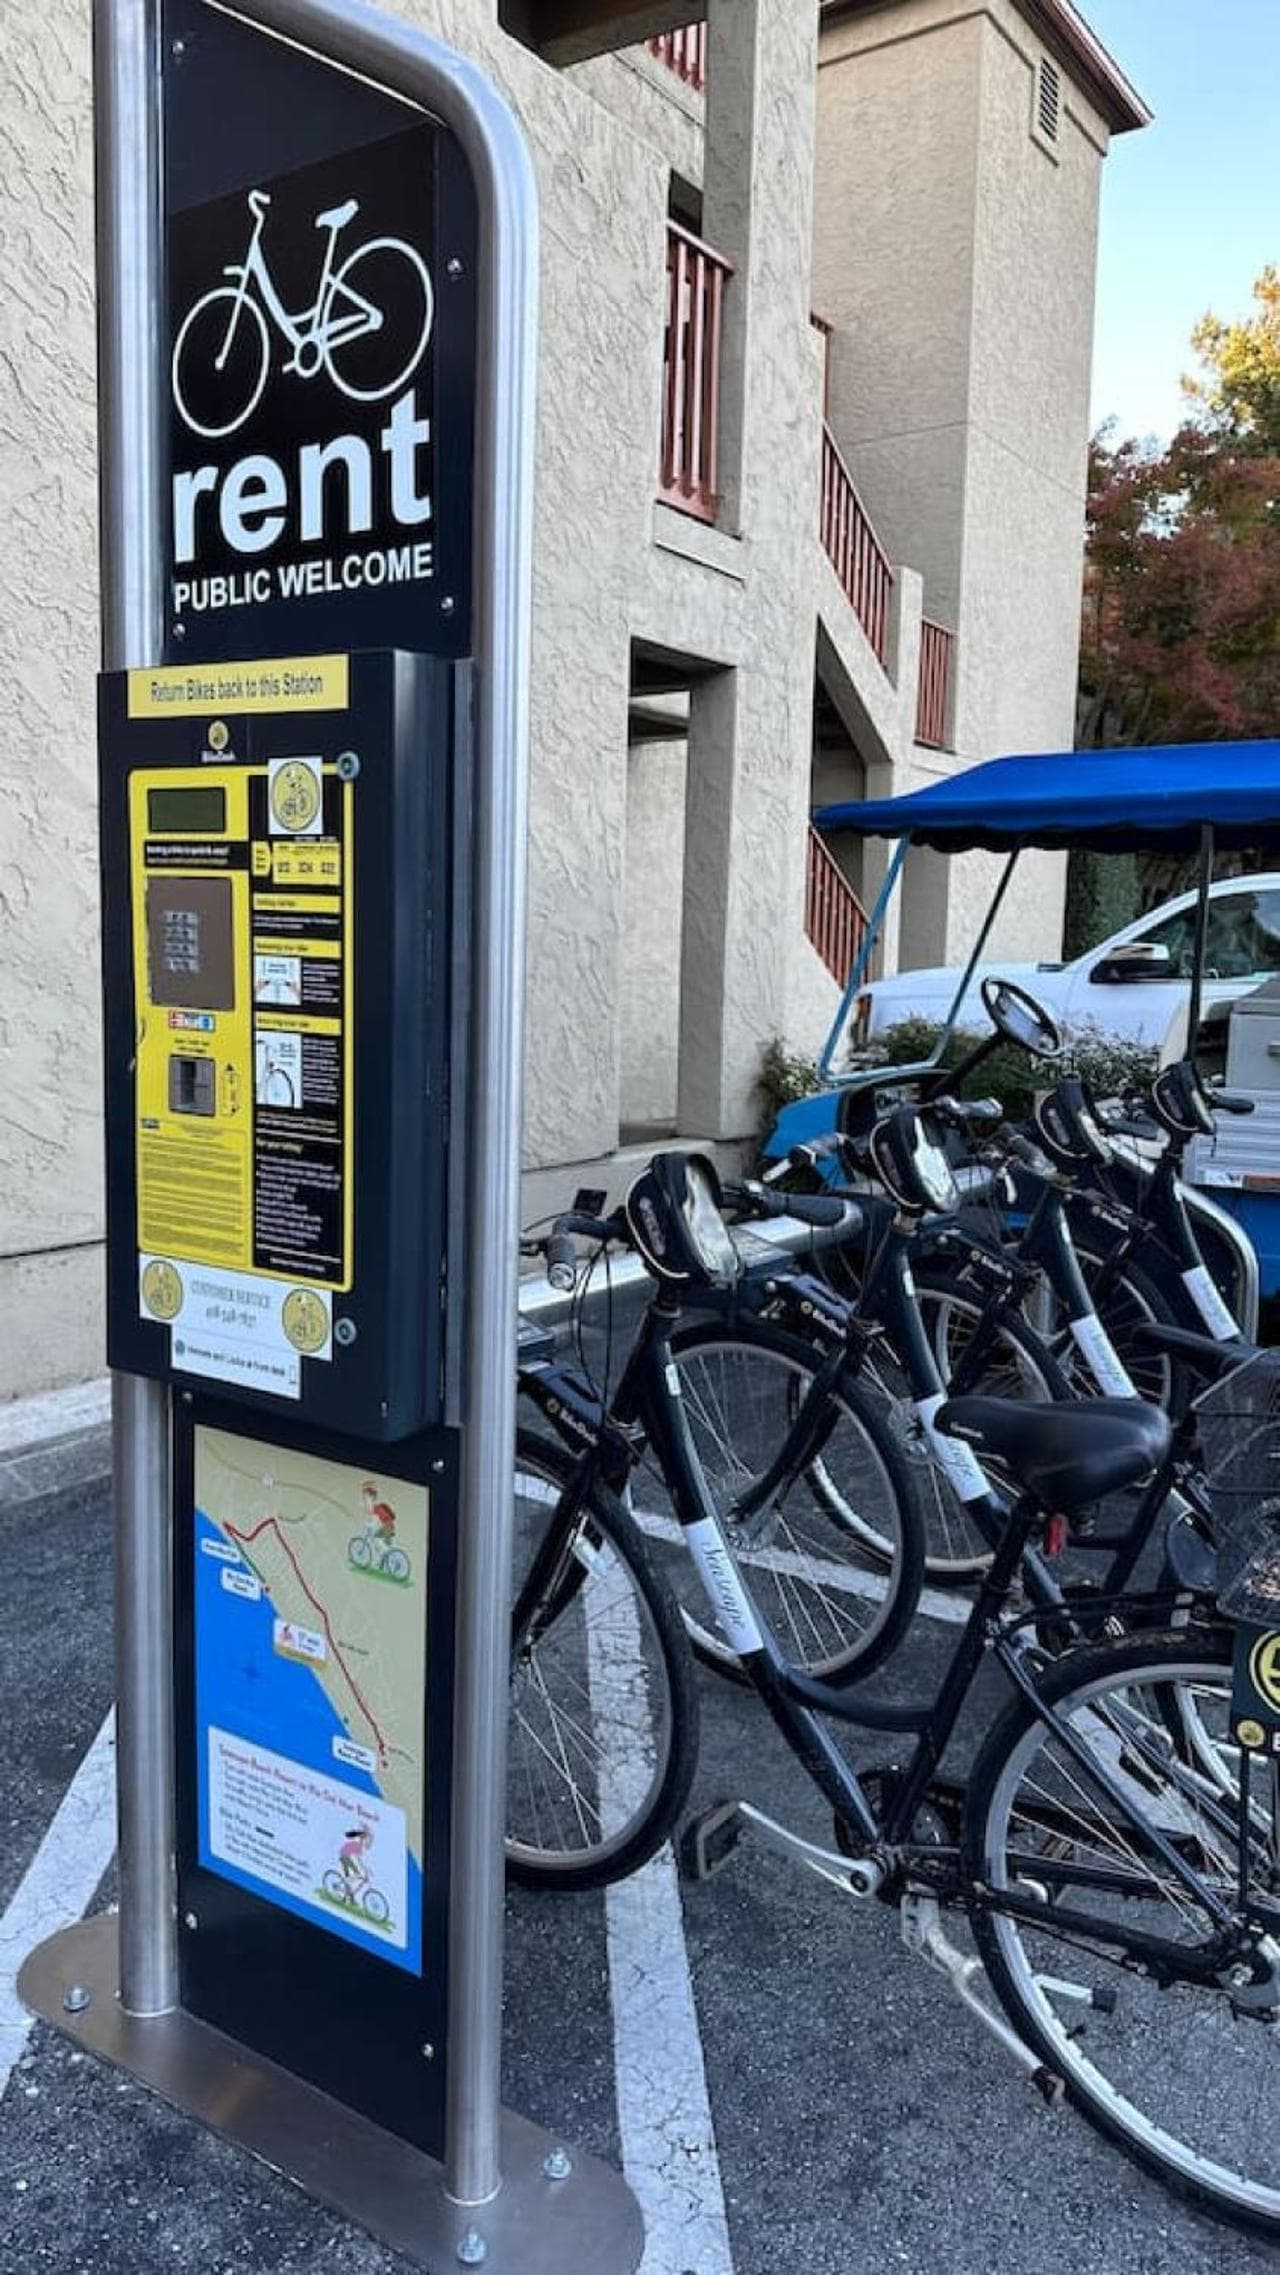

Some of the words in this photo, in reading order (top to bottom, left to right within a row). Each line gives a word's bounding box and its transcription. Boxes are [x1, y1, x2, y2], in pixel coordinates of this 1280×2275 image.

[173, 388, 431, 564] rent
[174, 570, 272, 613] PUBLIC
[277, 543, 433, 598] WELCOME
[151, 681, 183, 702] Return
[187, 678, 215, 701] Bikes
[218, 675, 243, 700] back
[246, 676, 257, 698] to
[259, 673, 280, 696] this
[284, 671, 323, 696] Station
